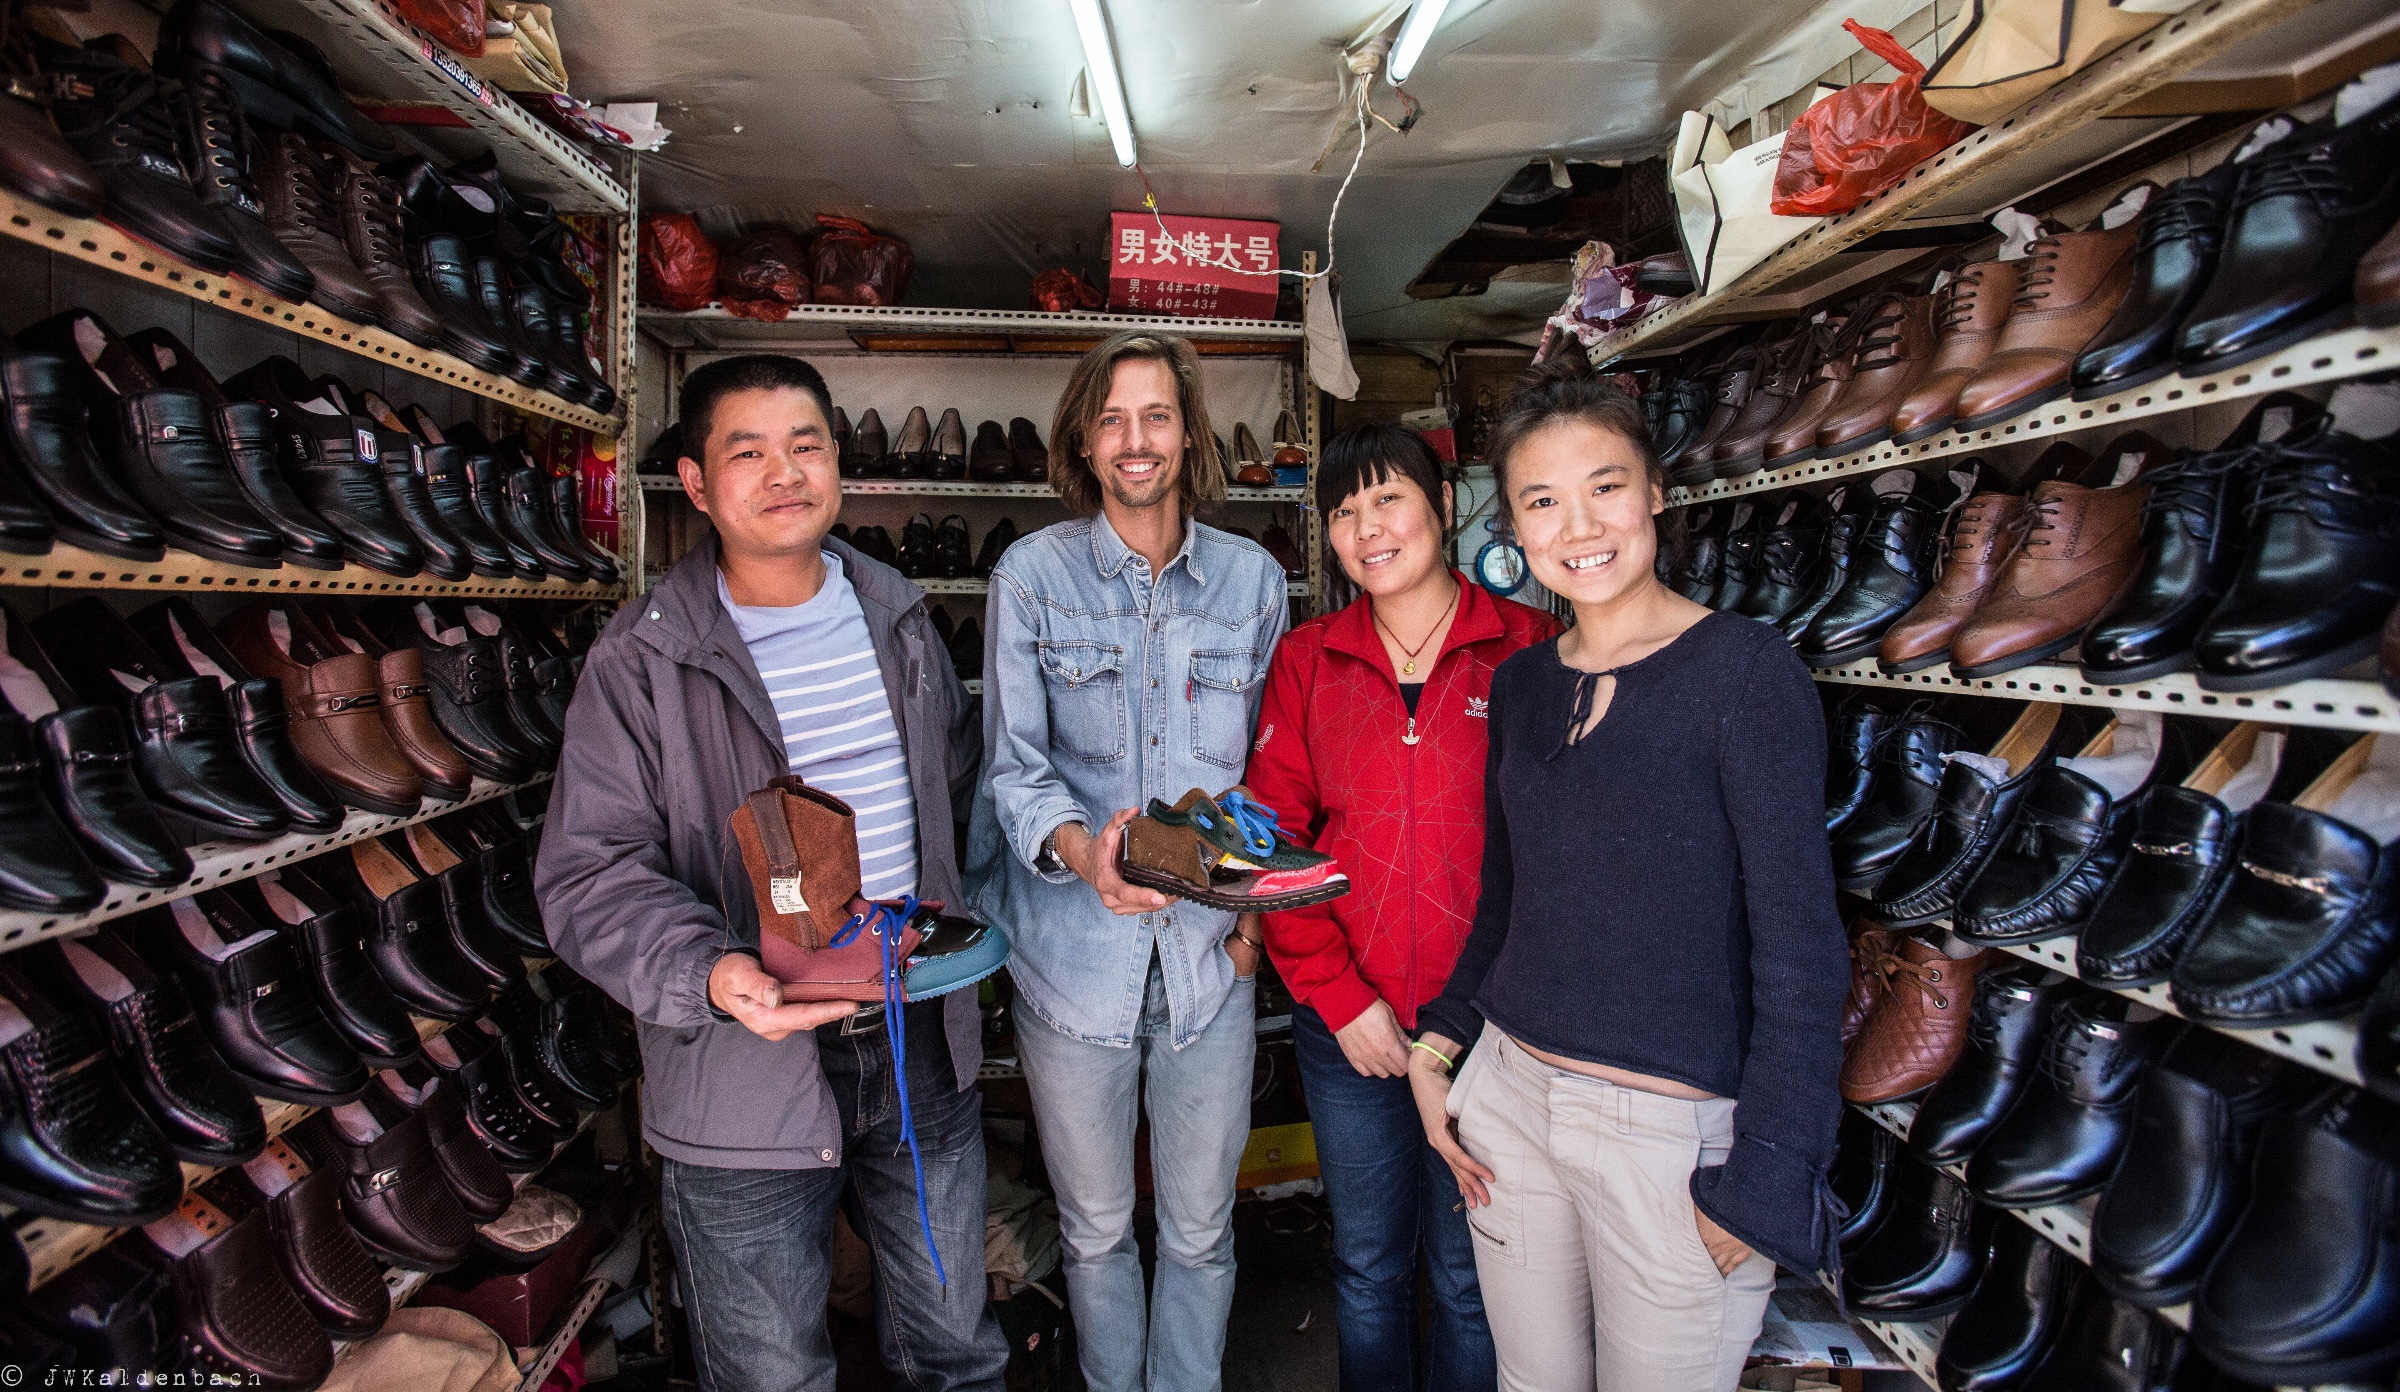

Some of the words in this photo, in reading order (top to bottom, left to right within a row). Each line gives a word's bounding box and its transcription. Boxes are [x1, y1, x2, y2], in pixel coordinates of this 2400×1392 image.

[433, 47, 482, 96] 13520391365
[1119, 228, 1273, 271] 男女特大号
[1157, 281, 1220, 295] 44#-48#
[1156, 297, 1218, 310] 40#-43#
[1464, 709, 1488, 718] adida
